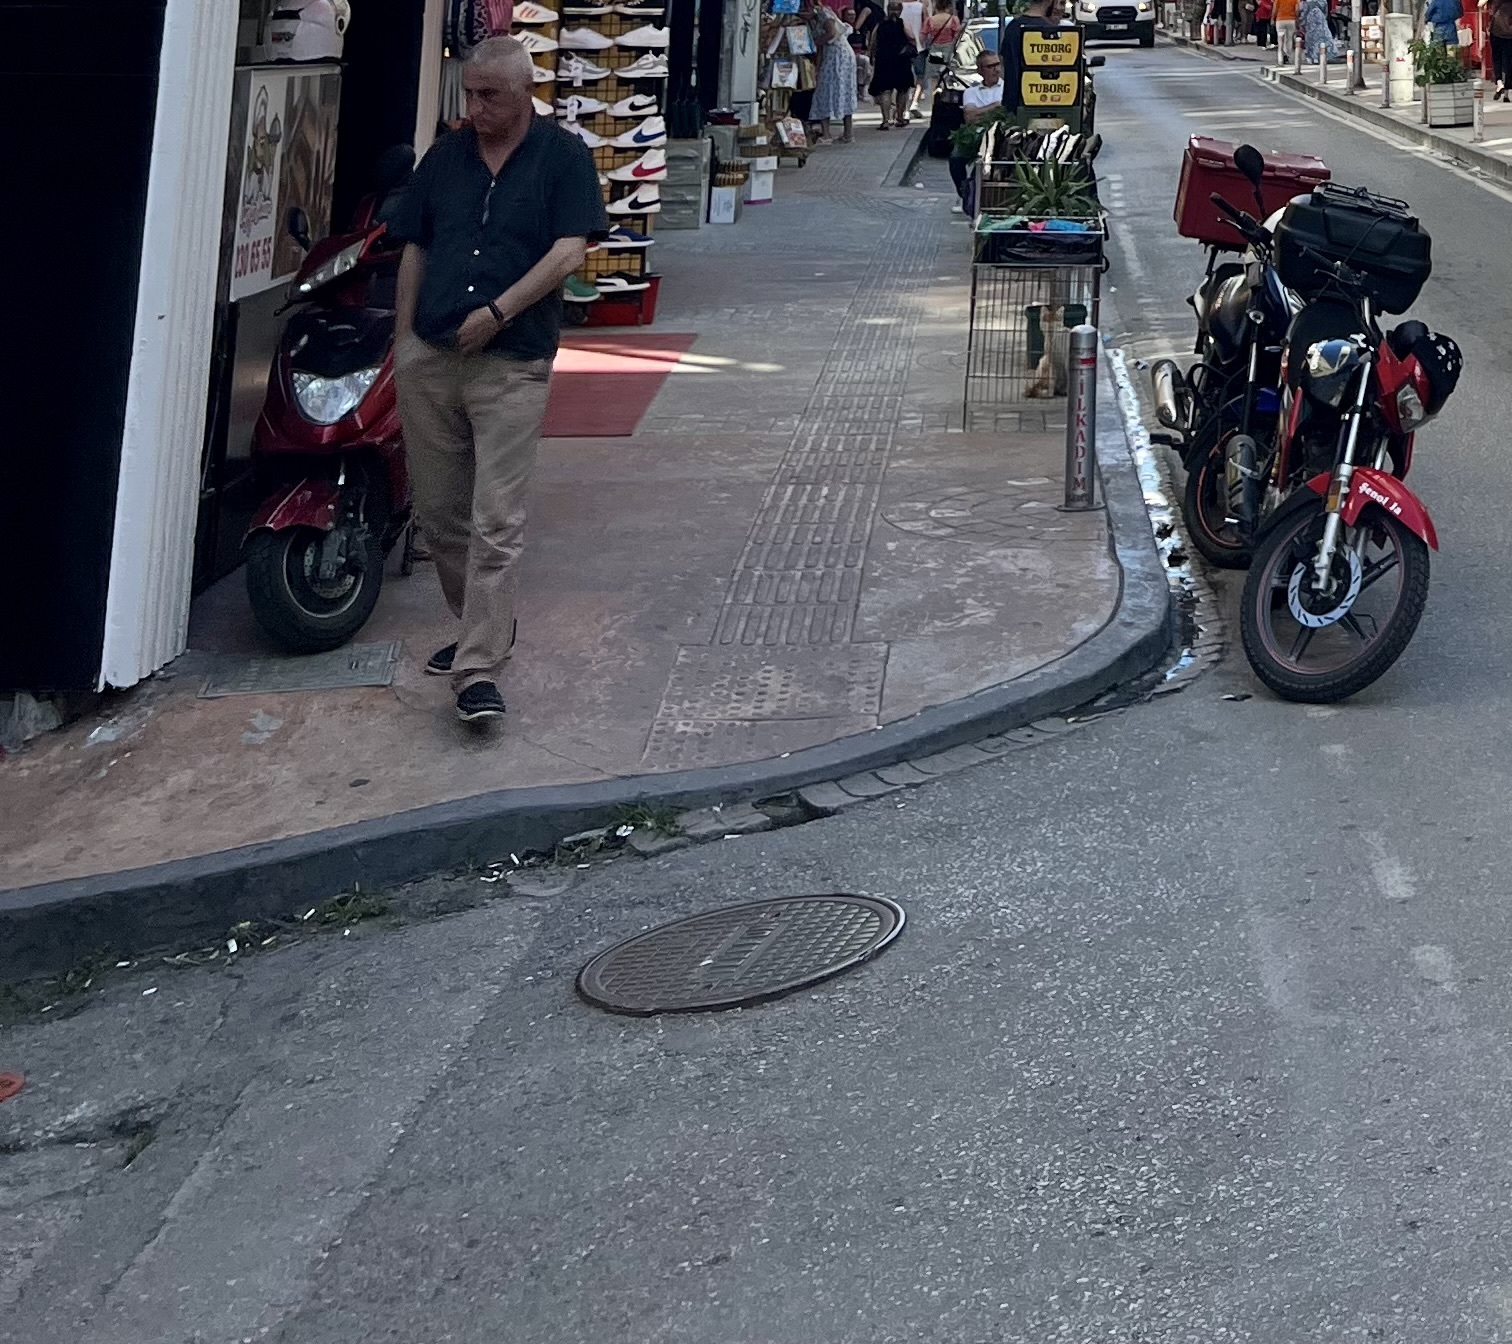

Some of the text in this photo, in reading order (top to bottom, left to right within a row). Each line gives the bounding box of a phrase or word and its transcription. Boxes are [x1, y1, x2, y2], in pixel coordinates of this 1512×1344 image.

[1029, 43, 1072, 55] TUBORG
[1028, 83, 1071, 95] TUBORG
[1358, 481, 1389, 506] Şenol
